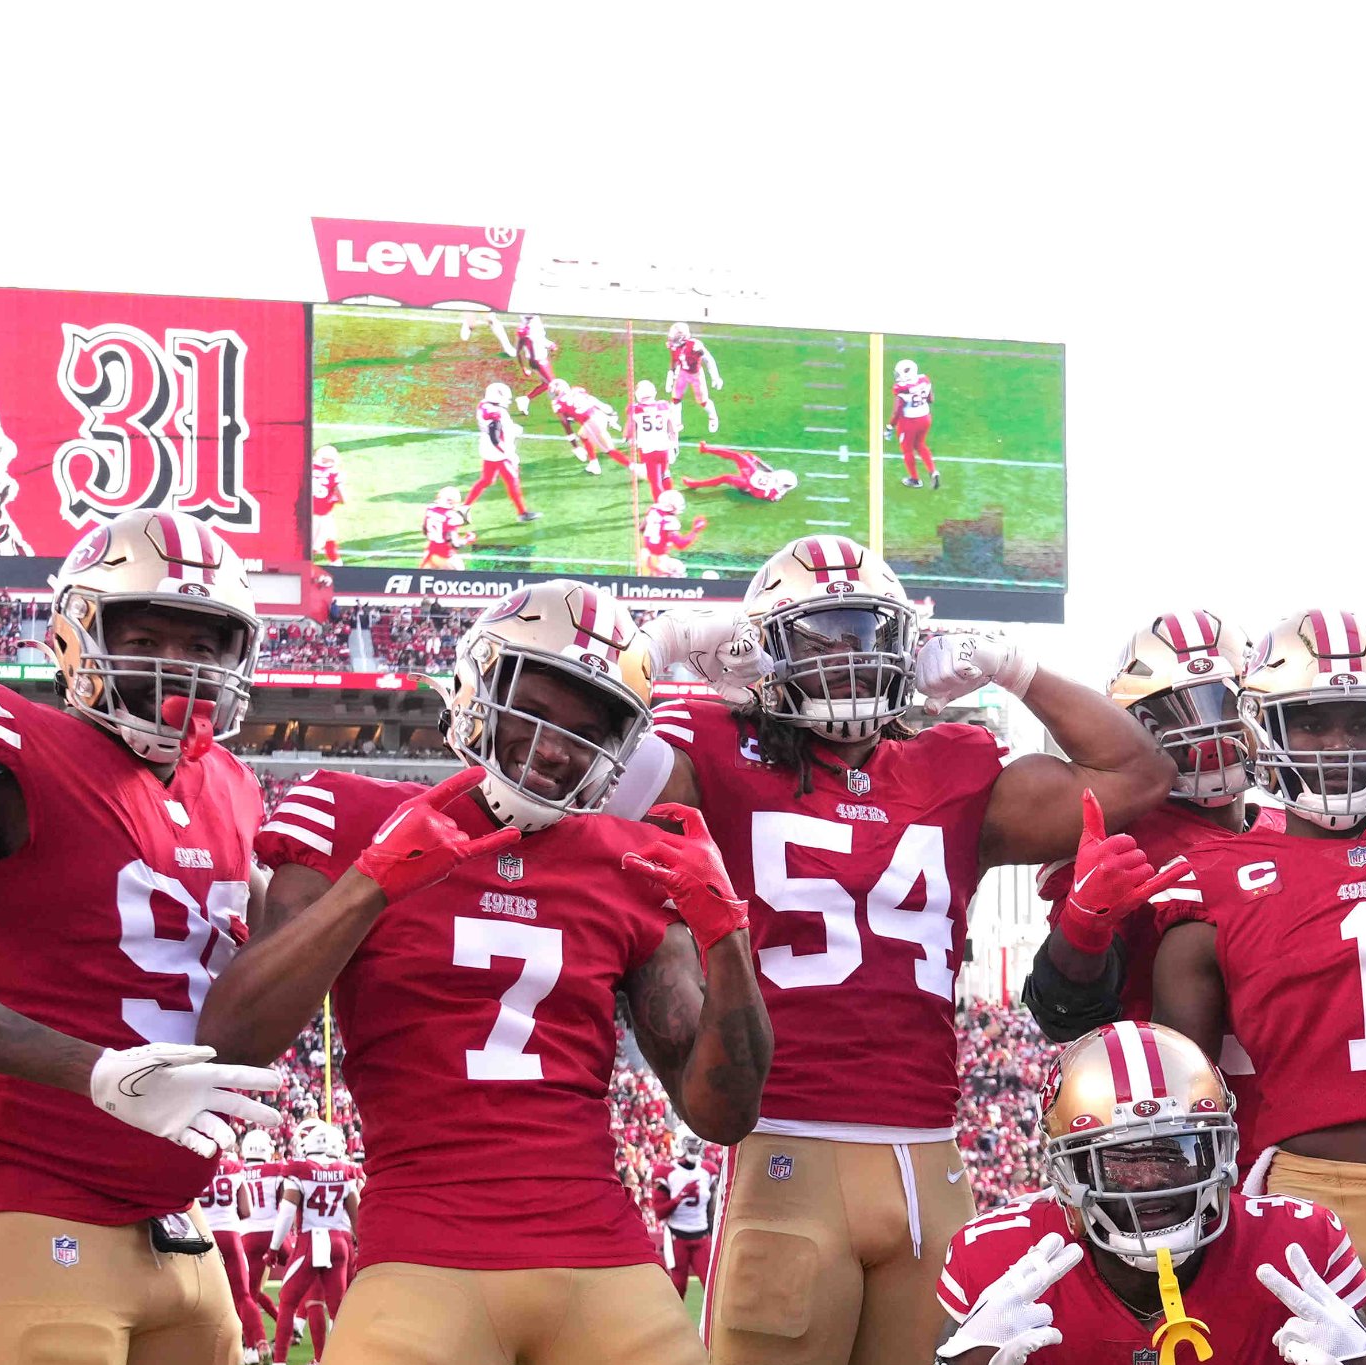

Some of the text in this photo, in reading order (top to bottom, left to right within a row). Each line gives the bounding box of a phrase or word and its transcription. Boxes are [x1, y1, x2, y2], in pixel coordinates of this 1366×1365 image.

[52, 322, 260, 533] 31
[420, 576, 513, 597] Foxconn
[623, 583, 704, 599] Internet
[835, 803, 889, 823] 49ERS
[1237, 861, 1278, 891] C
[480, 891, 537, 920] 49ERS
[751, 811, 955, 1003] 54
[452, 915, 564, 1081] 7
[311, 1169, 344, 1180] TURNER
[306, 1184, 345, 1217] 47
